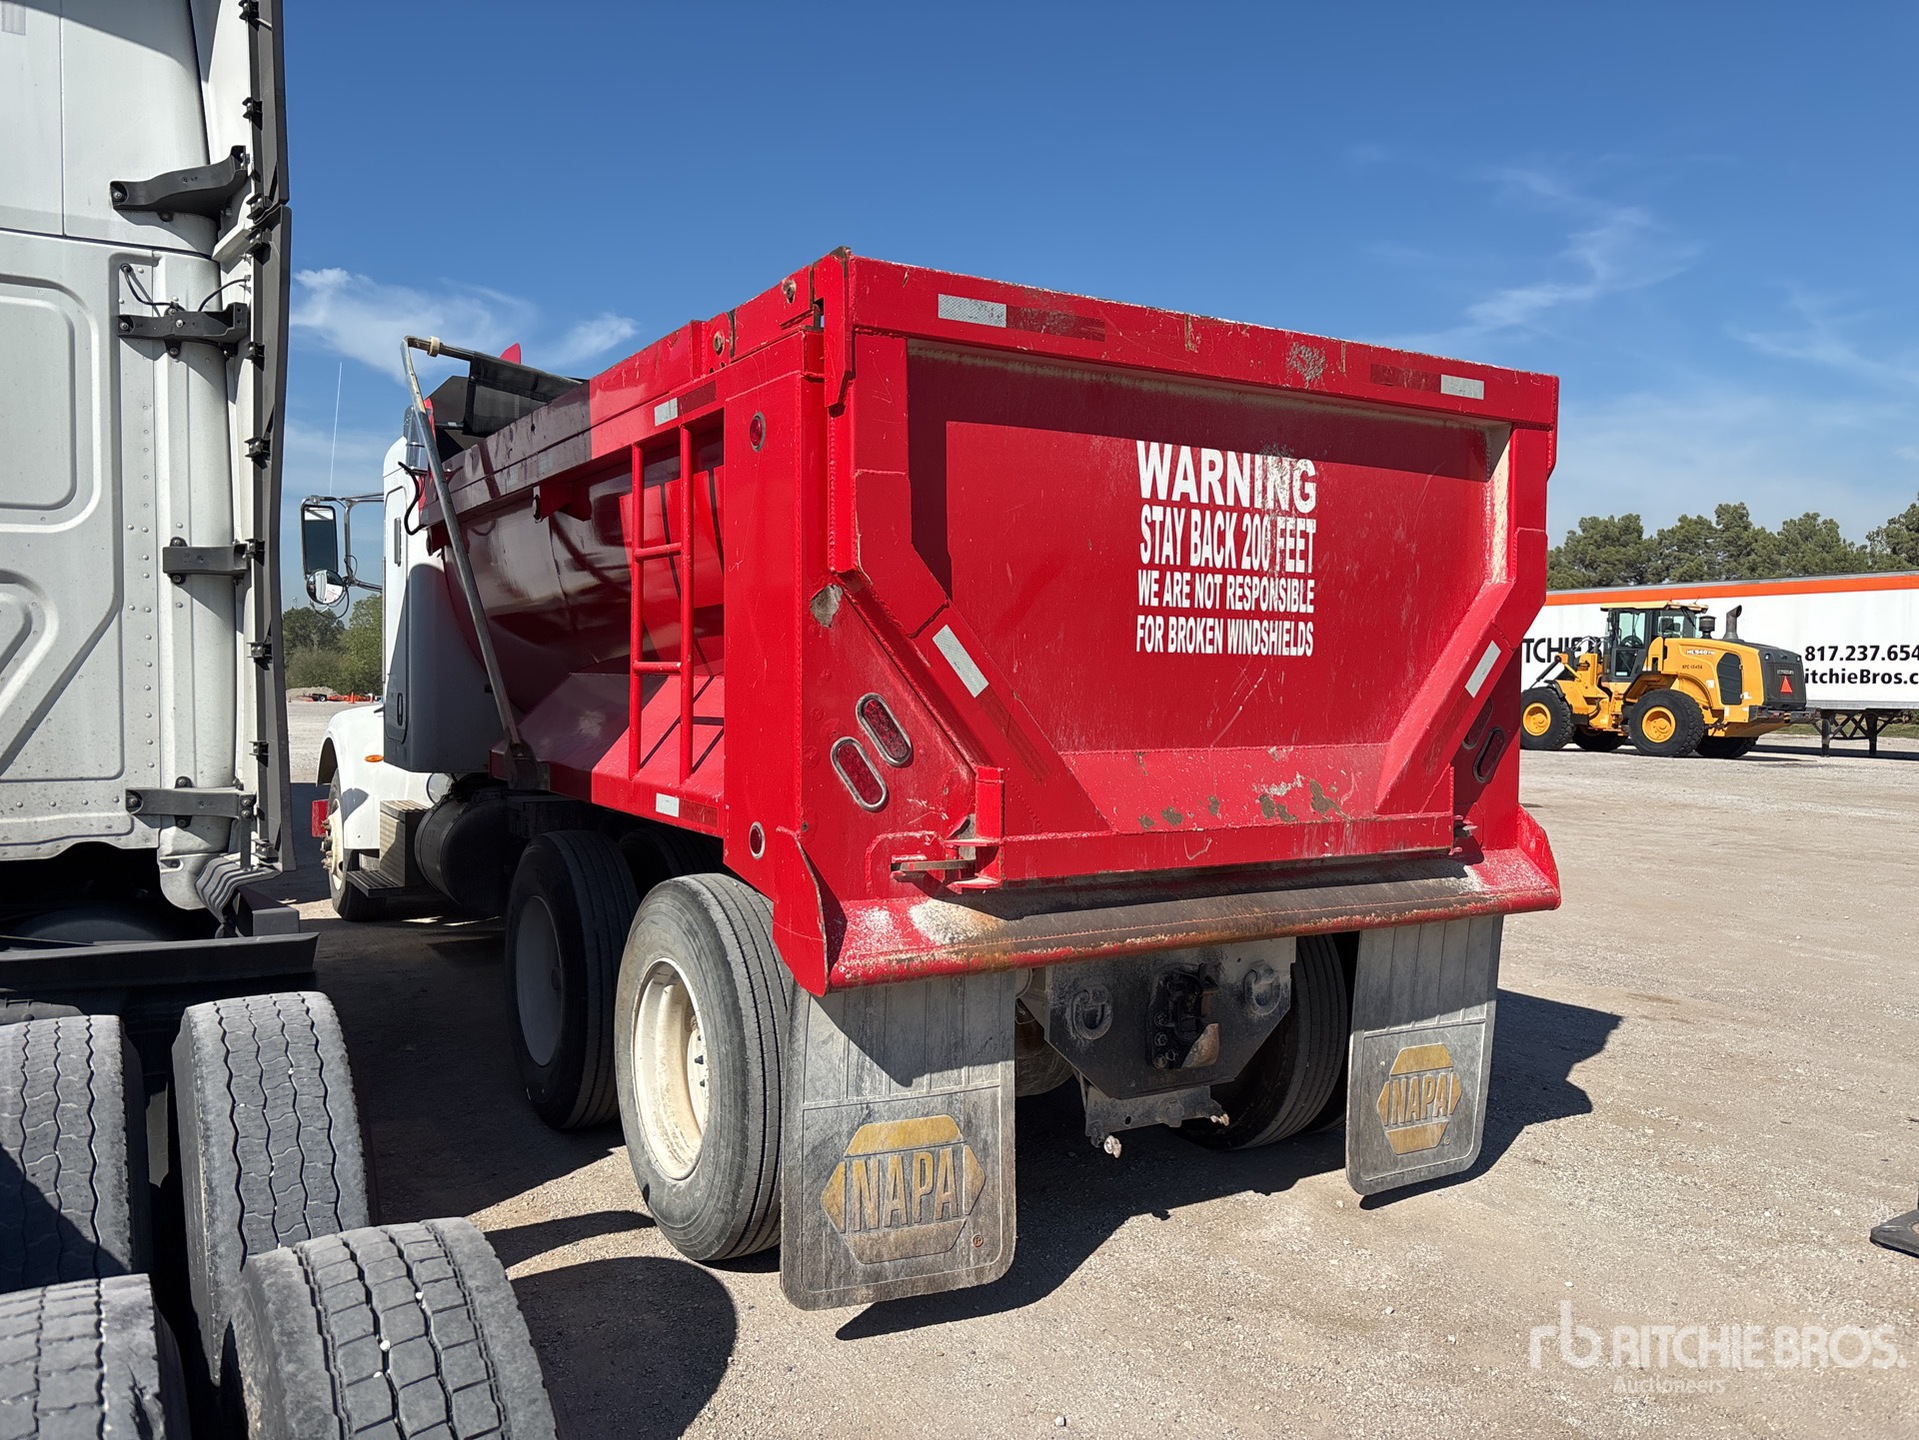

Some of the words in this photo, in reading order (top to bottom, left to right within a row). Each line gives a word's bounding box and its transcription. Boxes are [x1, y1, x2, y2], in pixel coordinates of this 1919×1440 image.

[1136, 440, 1317, 513] WARNING
[1140, 504, 1186, 565] STAY
[1190, 508, 1238, 569] BACK
[1241, 513, 1271, 571] 200
[1276, 516, 1317, 574] FEET
[1138, 569, 1160, 607] WE
[1162, 571, 1190, 608] ARE
[1194, 572, 1223, 610] NOT
[1226, 574, 1315, 613] RESPONSIBLE
[1136, 615, 1164, 652] FOR
[1167, 616, 1223, 654] BROKEN
[1227, 618, 1314, 657] WINDSHIELDS
[1391, 1072, 1447, 1125] NAPA
[852, 1148, 959, 1231] NAPA
